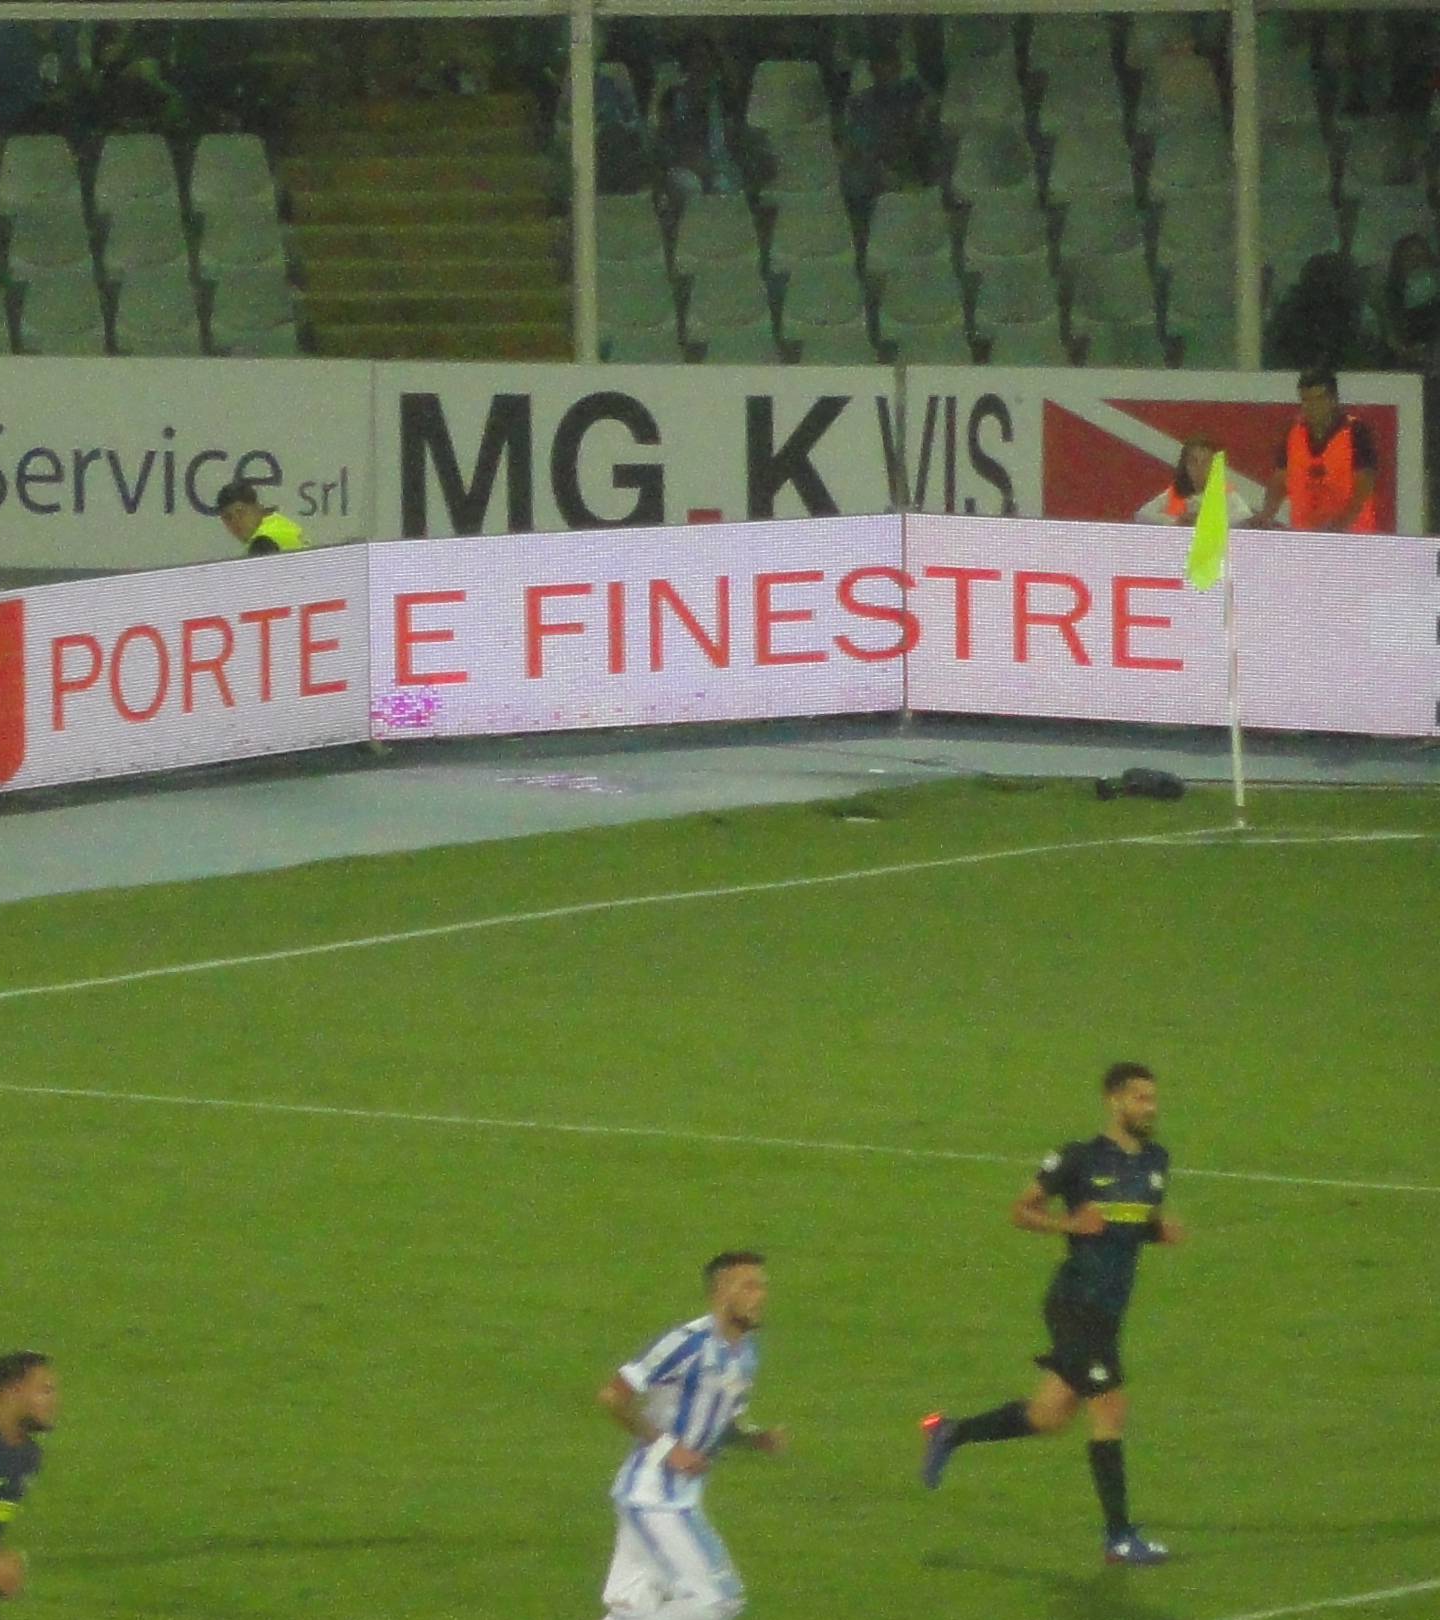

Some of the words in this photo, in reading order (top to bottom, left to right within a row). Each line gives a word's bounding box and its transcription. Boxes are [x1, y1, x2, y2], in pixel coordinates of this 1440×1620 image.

[298, 465, 349, 516] srl
[874, 392, 1014, 517] VIS
[50, 598, 349, 733] PORTE
[393, 589, 468, 687] E
[525, 565, 1185, 680] FINESTRE
